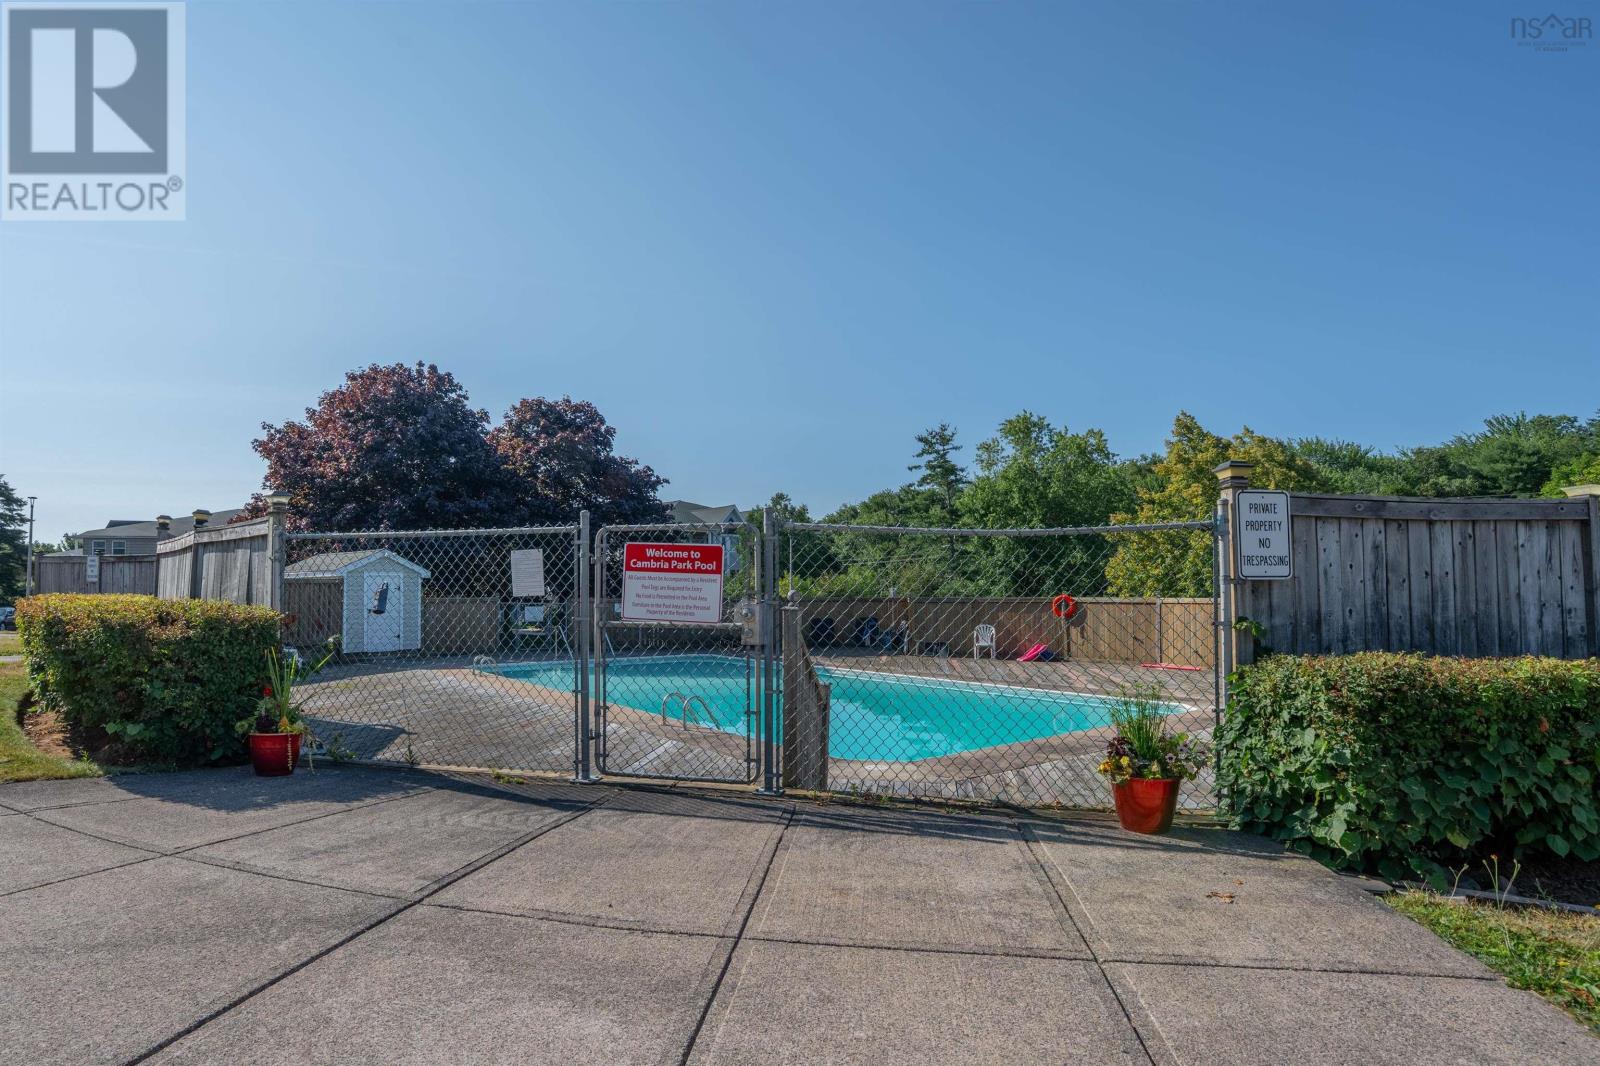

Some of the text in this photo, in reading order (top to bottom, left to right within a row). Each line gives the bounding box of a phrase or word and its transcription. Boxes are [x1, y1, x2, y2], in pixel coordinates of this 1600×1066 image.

[1248, 502, 1278, 514] PRIVATE
[1245, 520, 1282, 532] PROPERTY
[1258, 537, 1271, 549] NO
[645, 548, 701, 559] Welcome to
[630, 559, 717, 571] Cambria Park Pool
[1242, 555, 1289, 567] TRESPASSING
